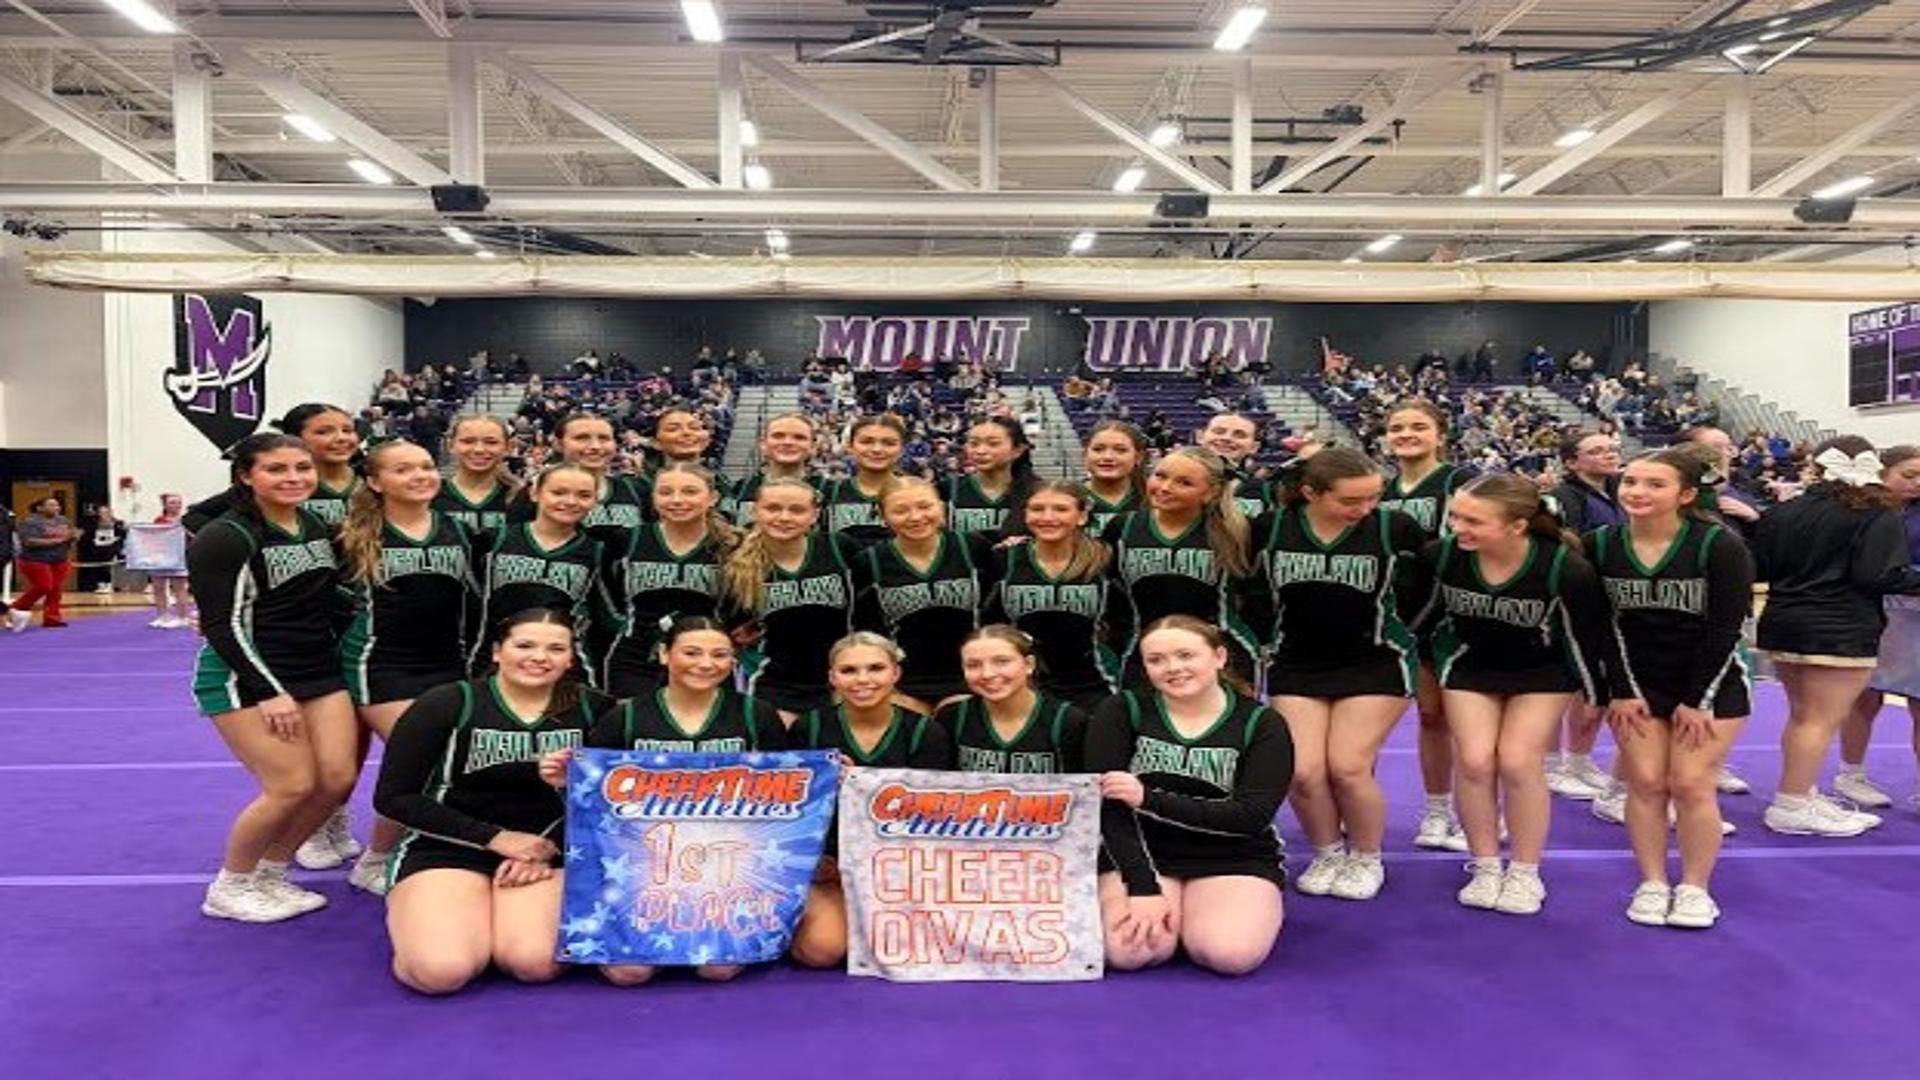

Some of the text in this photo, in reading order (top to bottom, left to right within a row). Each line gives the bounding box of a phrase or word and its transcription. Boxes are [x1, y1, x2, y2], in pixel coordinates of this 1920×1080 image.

[814, 315, 1273, 373] MOUNT UNION
[1851, 310, 1888, 334] HOME
[1889, 306, 1908, 327] OF
[872, 848, 1063, 903] CHEER
[872, 910, 1071, 965] DIVAS
